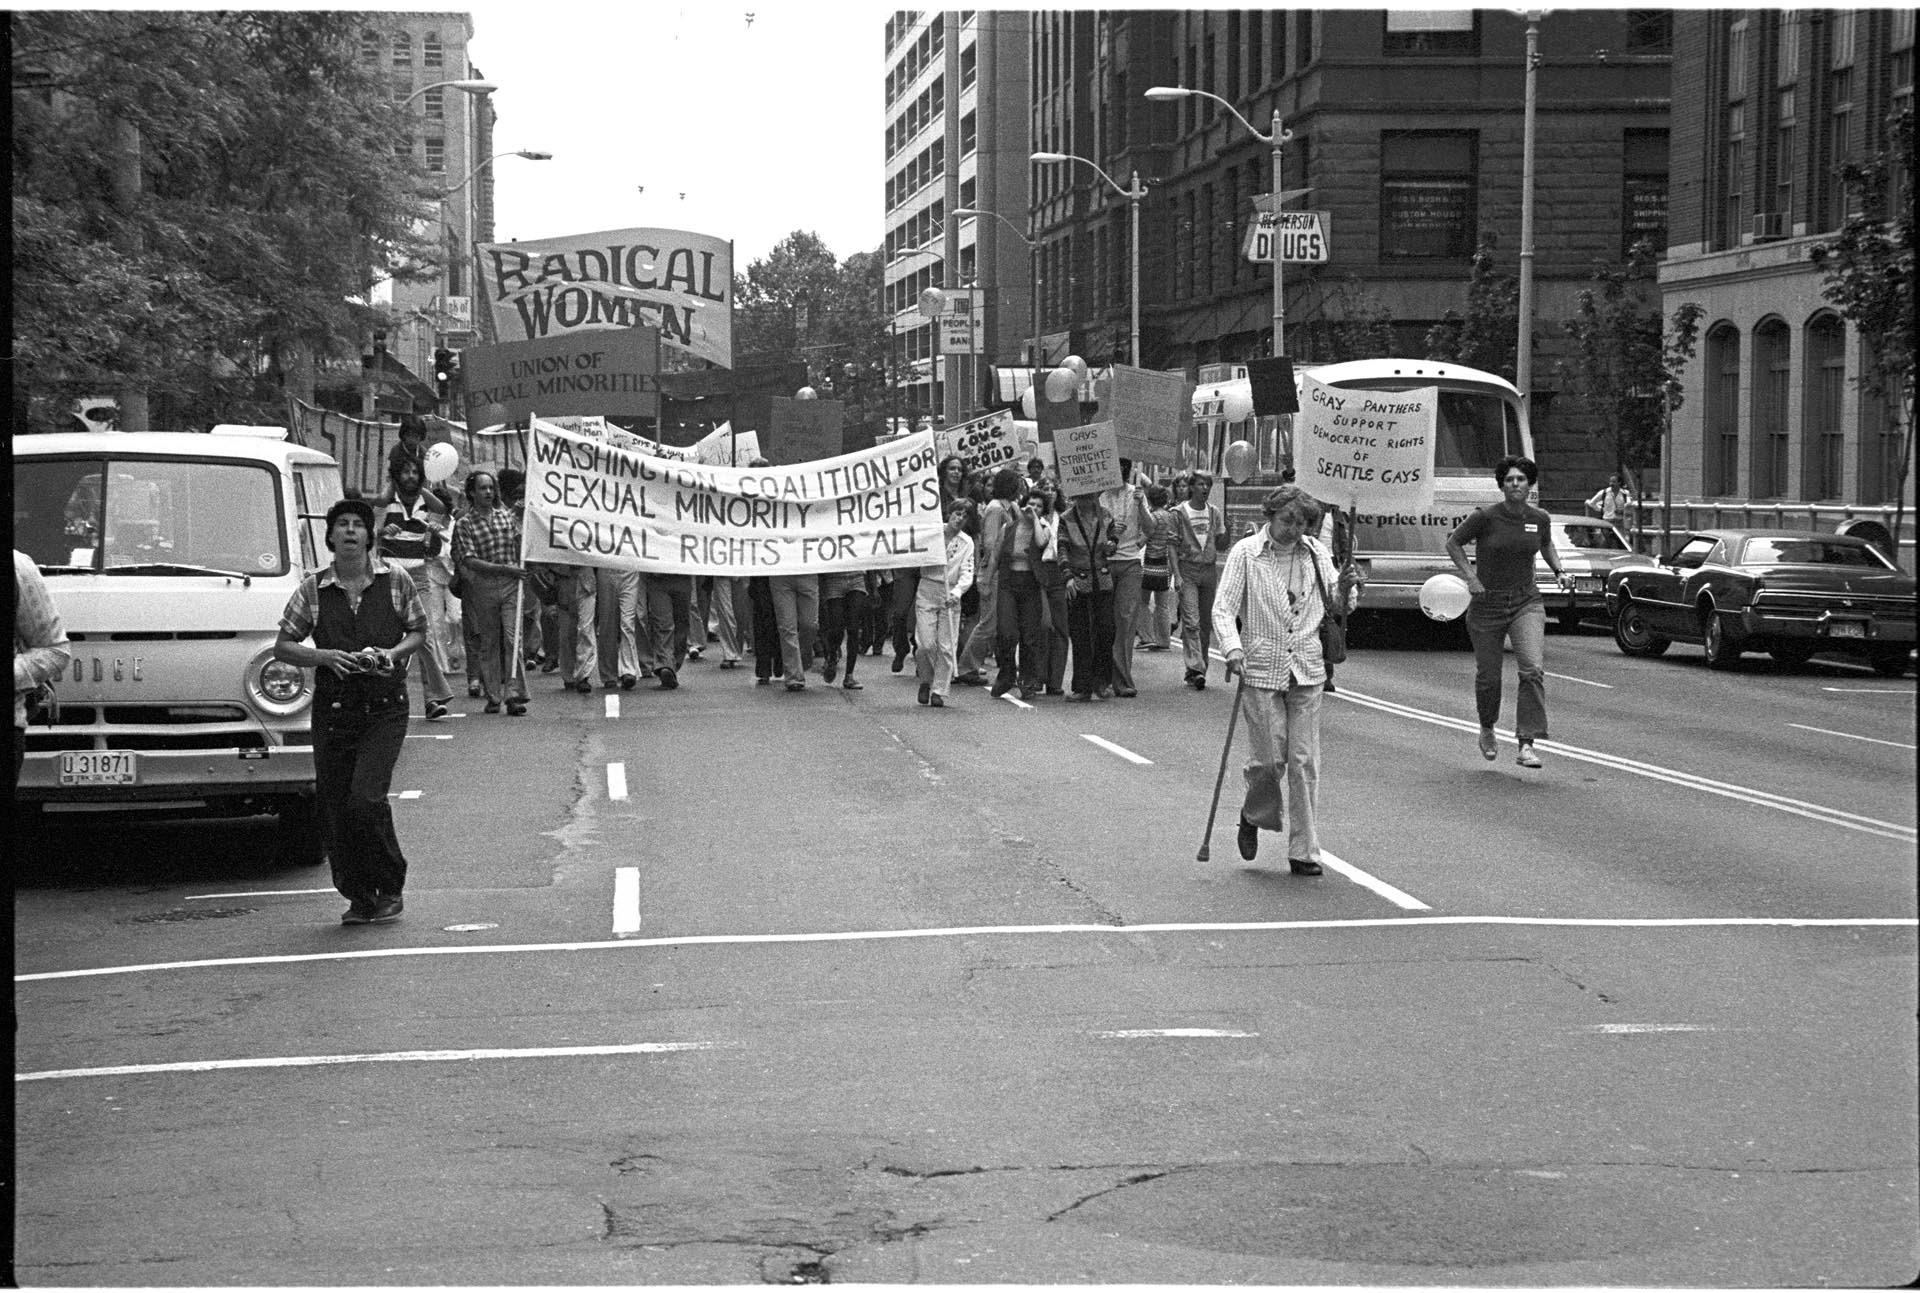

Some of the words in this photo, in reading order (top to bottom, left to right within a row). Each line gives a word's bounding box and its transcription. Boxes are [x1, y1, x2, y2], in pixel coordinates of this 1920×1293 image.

[1257, 233, 1320, 260] DUGS
[488, 245, 724, 302] RADICAL
[514, 284, 695, 346] WOMEN
[943, 319, 981, 327] PEOPLS
[950, 336, 971, 345] BAN
[511, 355, 569, 379] UNION
[575, 352, 605, 370] OF
[537, 373, 661, 397] MINORITIES
[1312, 388, 1346, 411] GRAY
[1363, 400, 1422, 414] PANTHERS
[965, 421, 988, 435] IN
[1333, 415, 1397, 431] SUPPORT
[1069, 430, 1098, 441] GAYS
[1313, 425, 1377, 447] DEMOCRATIC
[1387, 436, 1424, 449] RIGHTS
[963, 445, 1014, 470] PROUD
[977, 442, 997, 454] AND
[1060, 449, 1112, 465] STRAIGHTS
[1353, 451, 1369, 462] OF
[534, 430, 718, 493] WASHINGTON
[739, 457, 892, 499] COALITION
[896, 448, 936, 476] FOR
[1072, 461, 1108, 475] UNITE
[1317, 458, 1374, 481] SEATTLE
[1381, 468, 1421, 483] GAYS
[542, 471, 656, 519] SEXUAL
[676, 491, 814, 528] MINORITY
[837, 478, 940, 525] RIGHTS
[1376, 512, 1417, 528] price
[1421, 513, 1448, 526] tire
[548, 516, 660, 560] EQUAL
[680, 534, 781, 566] RIGHTS
[802, 534, 858, 564] FOR
[871, 525, 929, 555] ALL
[63, 756, 73, 773] U
[80, 755, 129, 773] 31871
